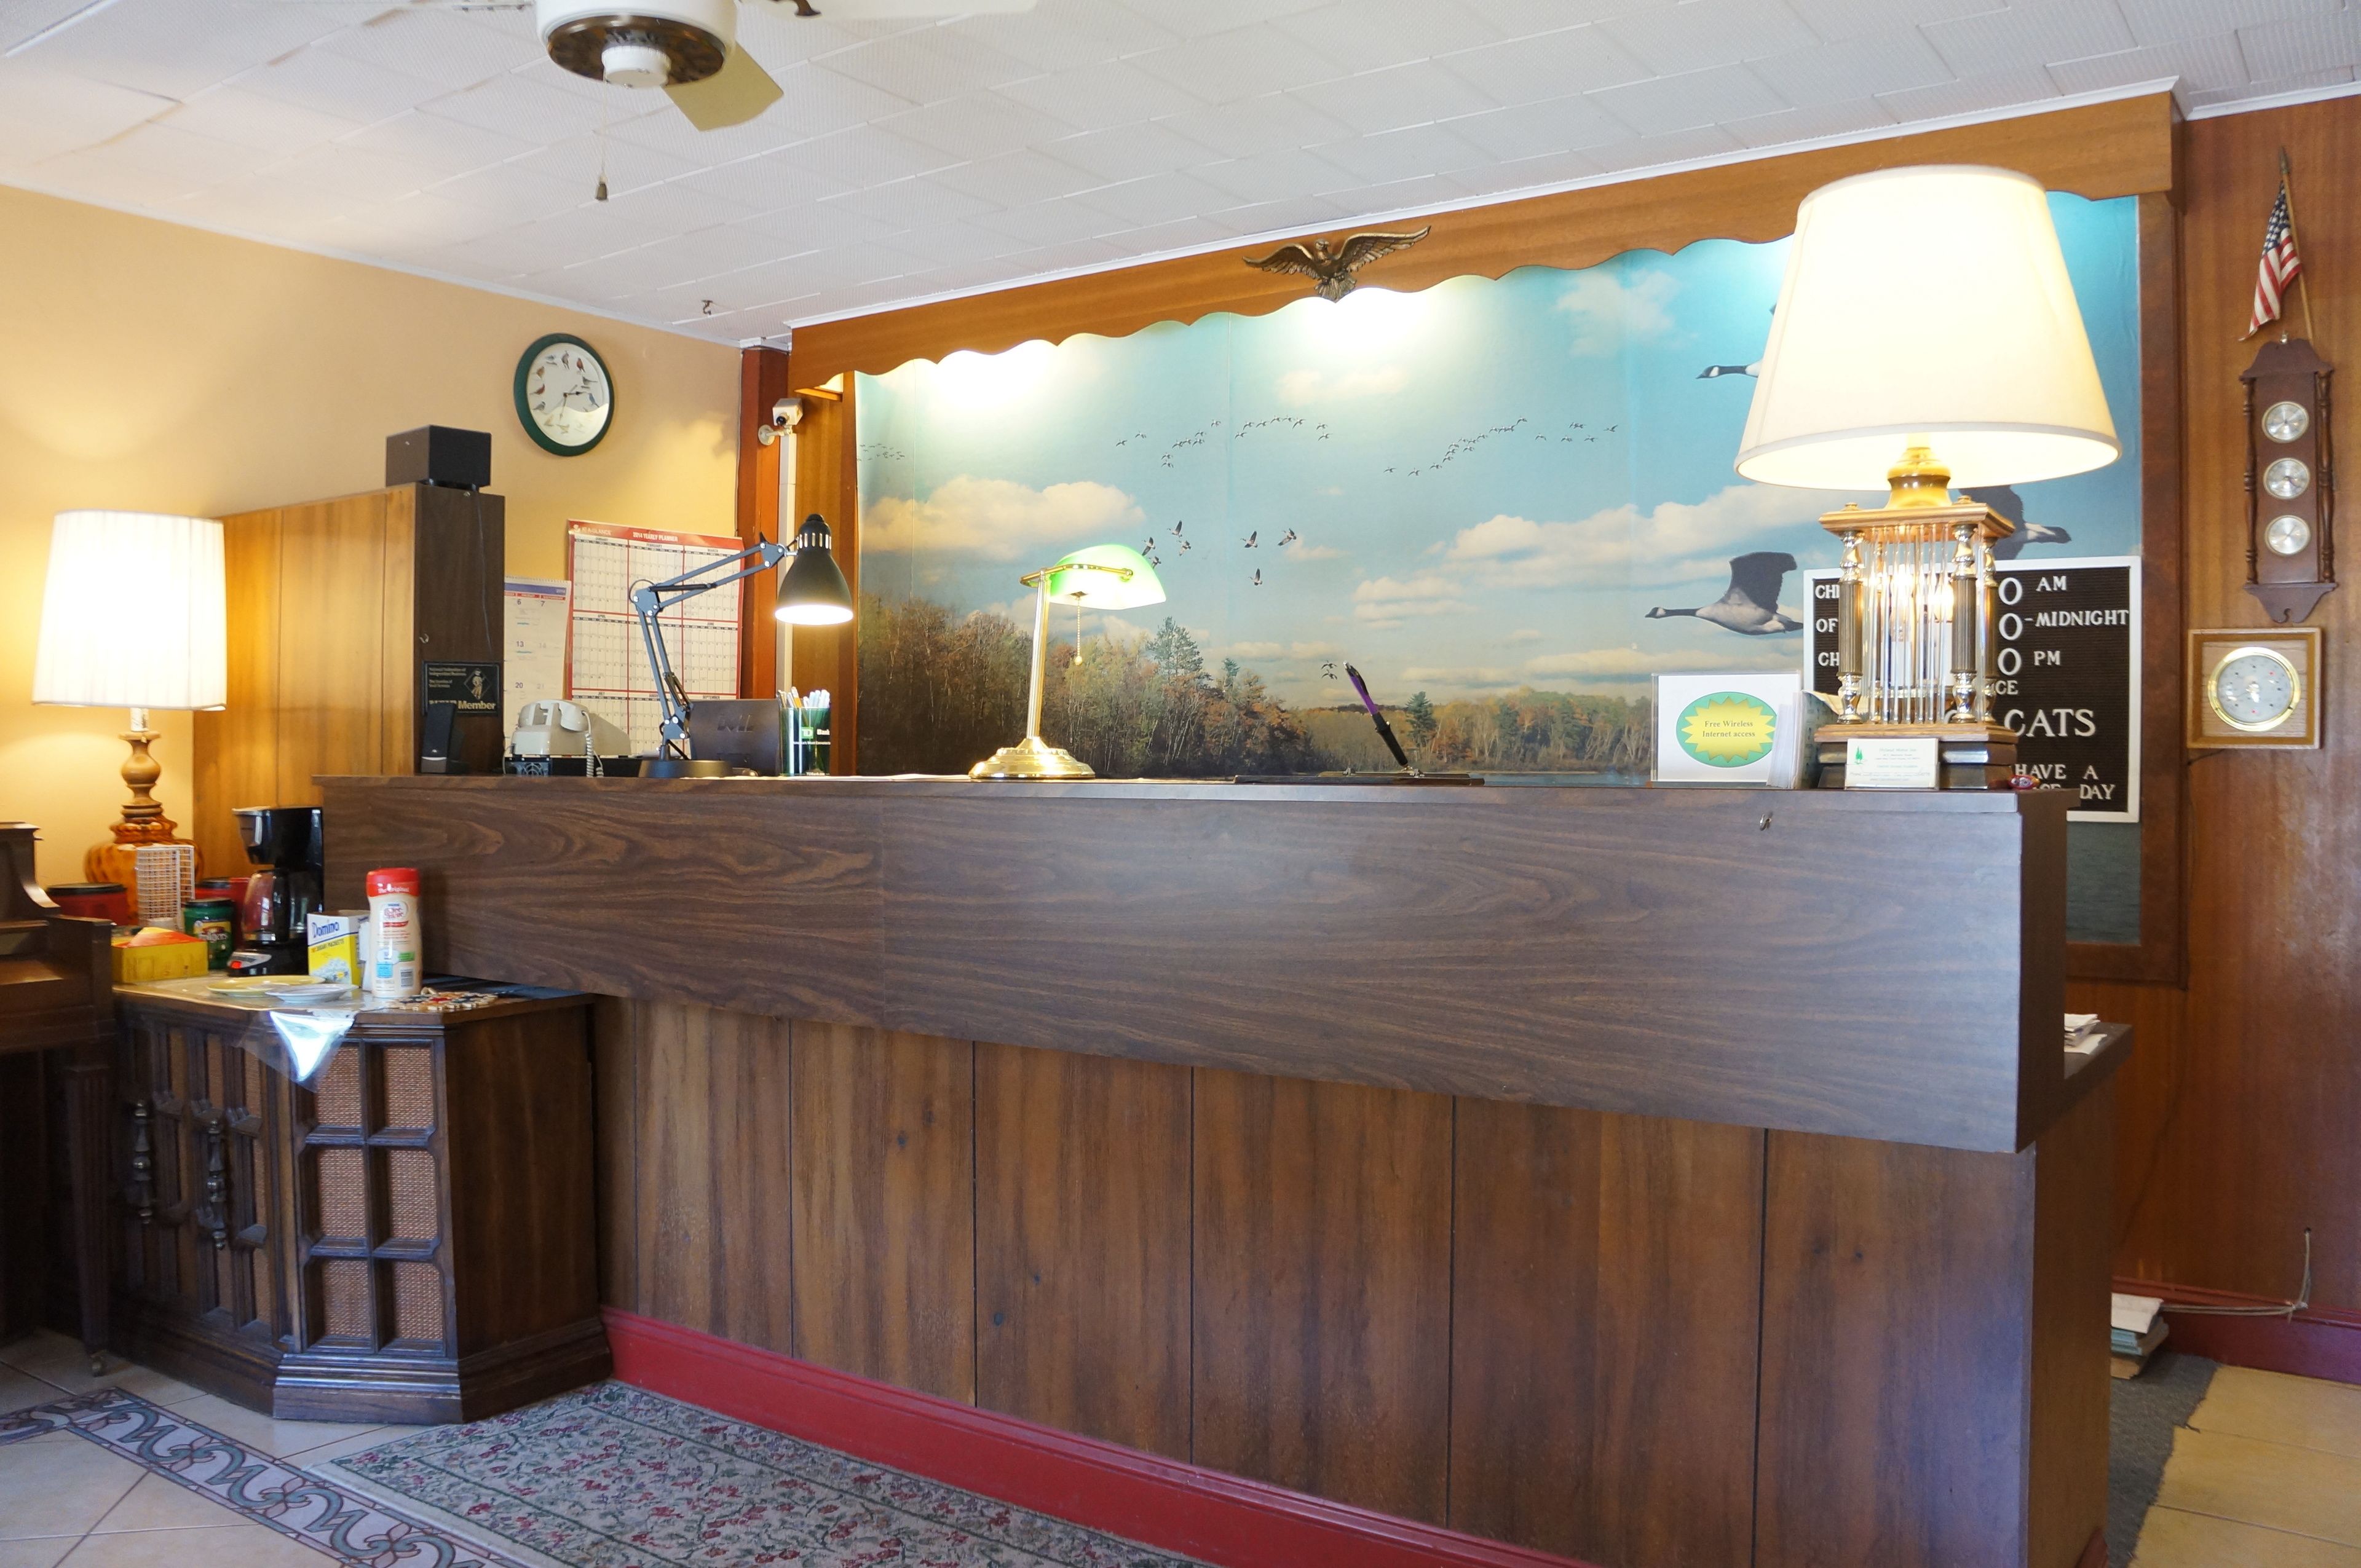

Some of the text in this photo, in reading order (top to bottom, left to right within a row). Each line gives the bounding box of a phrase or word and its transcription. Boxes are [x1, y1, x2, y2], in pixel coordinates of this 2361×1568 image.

[2036, 575, 2067, 592] AM
[2033, 650, 2061, 666] PM
[457, 700, 496, 710] Member
[2004, 709, 2096, 737] CATS
[2015, 764, 2099, 780] HAVE A
[2079, 784, 2115, 800] DAY
[312, 921, 340, 939] Domino
